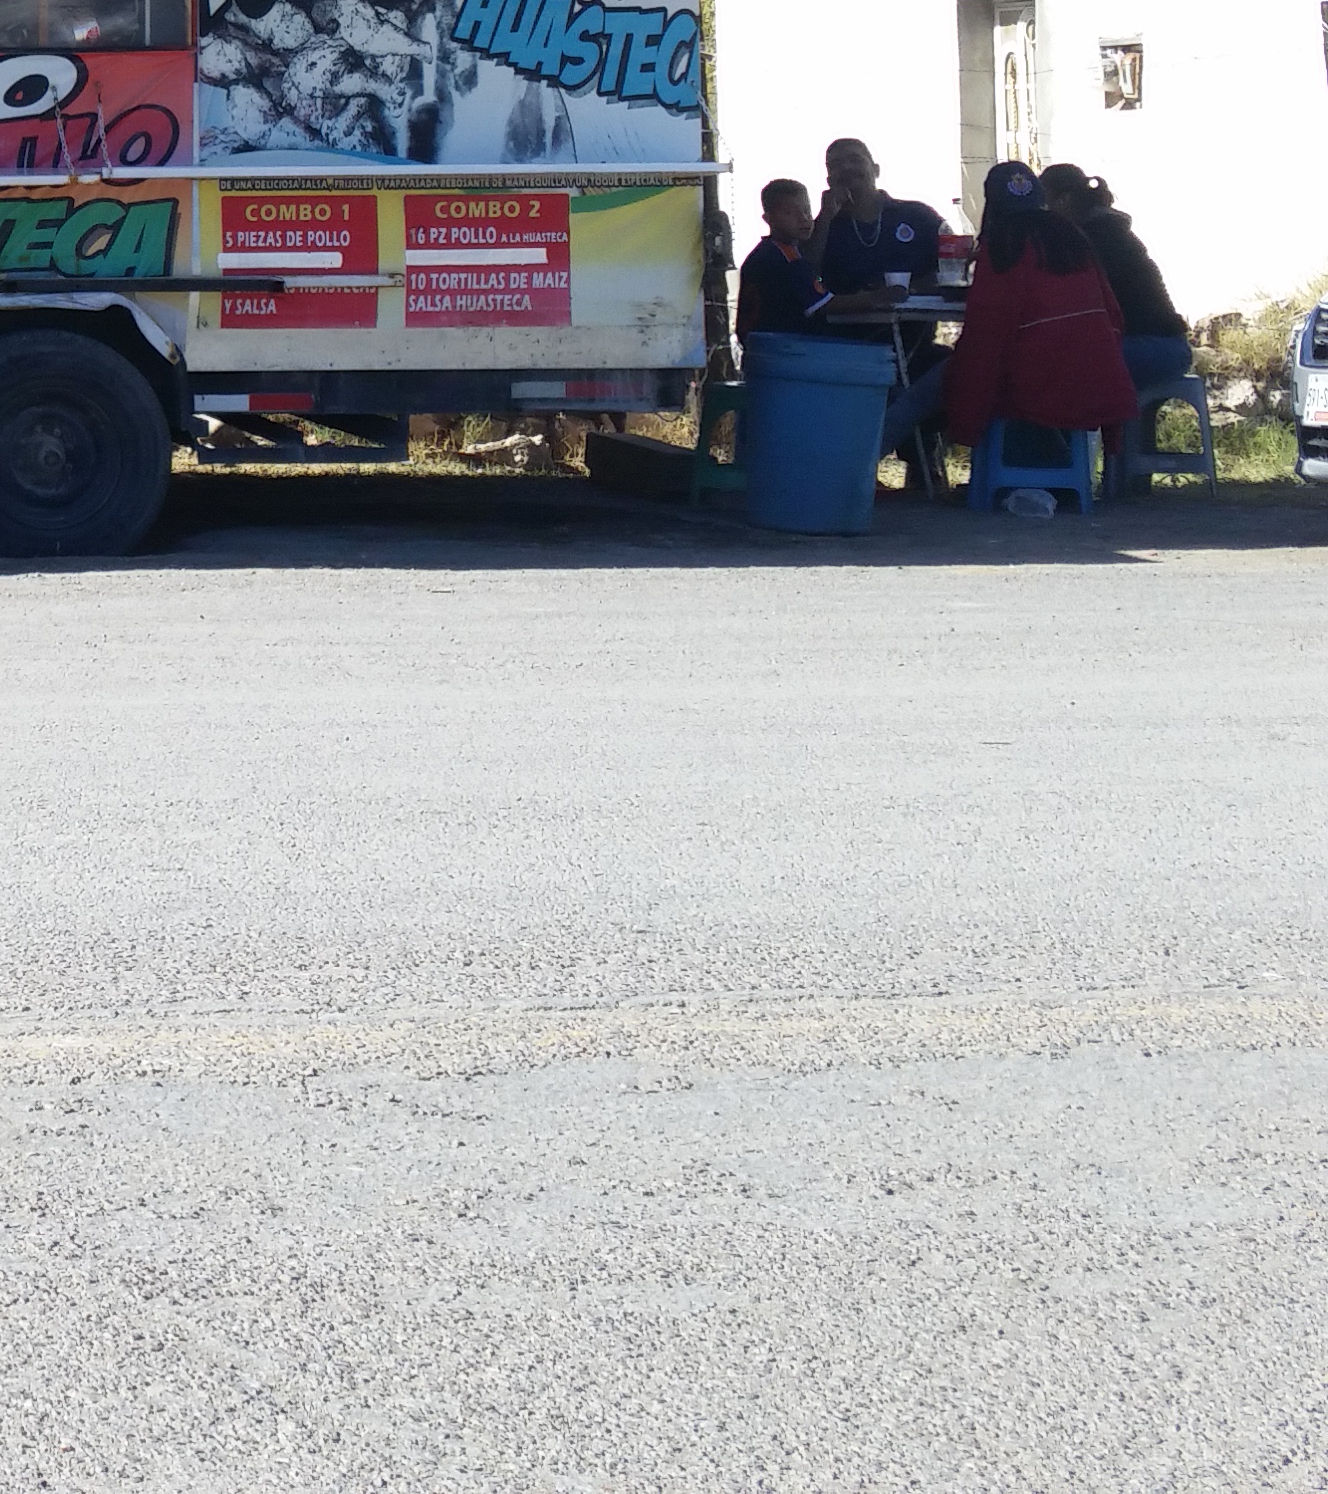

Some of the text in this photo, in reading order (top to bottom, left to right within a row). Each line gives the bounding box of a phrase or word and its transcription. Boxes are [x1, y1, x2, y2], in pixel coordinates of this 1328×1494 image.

[245, 203, 350, 221] COMBO 1
[434, 200, 541, 218] COMBO 2
[225, 229, 351, 247] 5 PIEZAS DE POLLO
[430, 227, 447, 244] PZ
[451, 226, 496, 243] POLLO
[500, 234, 507, 243] A
[510, 233, 520, 243] LA
[522, 232, 568, 243] HUASTECA
[410, 271, 568, 290] 10 TORTILLAS DE MAIZ
[224, 298, 277, 314] Y SALSA
[408, 294, 533, 312] SALSA HUASTECA
